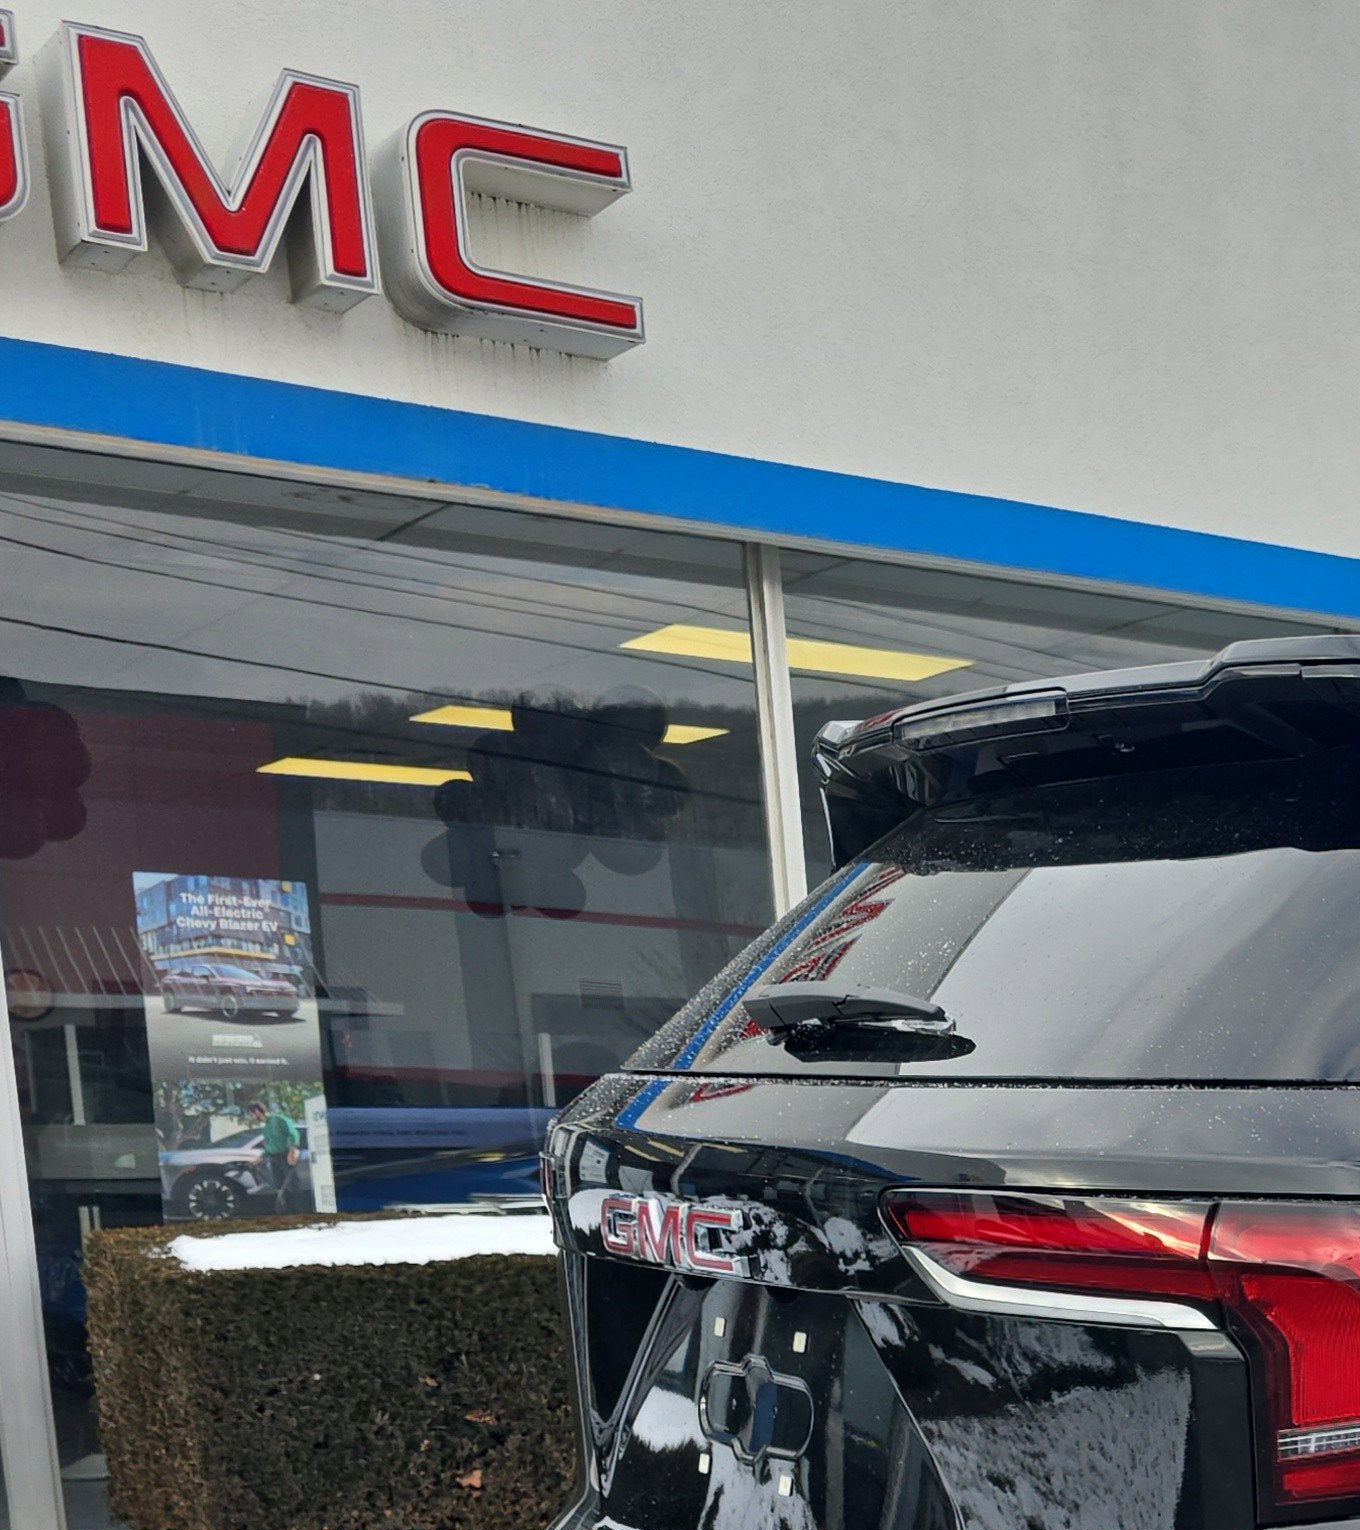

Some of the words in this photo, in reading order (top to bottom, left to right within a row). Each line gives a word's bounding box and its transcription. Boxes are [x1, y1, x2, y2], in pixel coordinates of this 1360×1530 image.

[179, 893, 205, 904] The
[190, 905, 264, 919] All-Electric
[176, 916, 217, 931] Chevy
[219, 919, 261, 931] Blazer
[261, 920, 279, 932] EV
[600, 1197, 748, 1277] GMC
